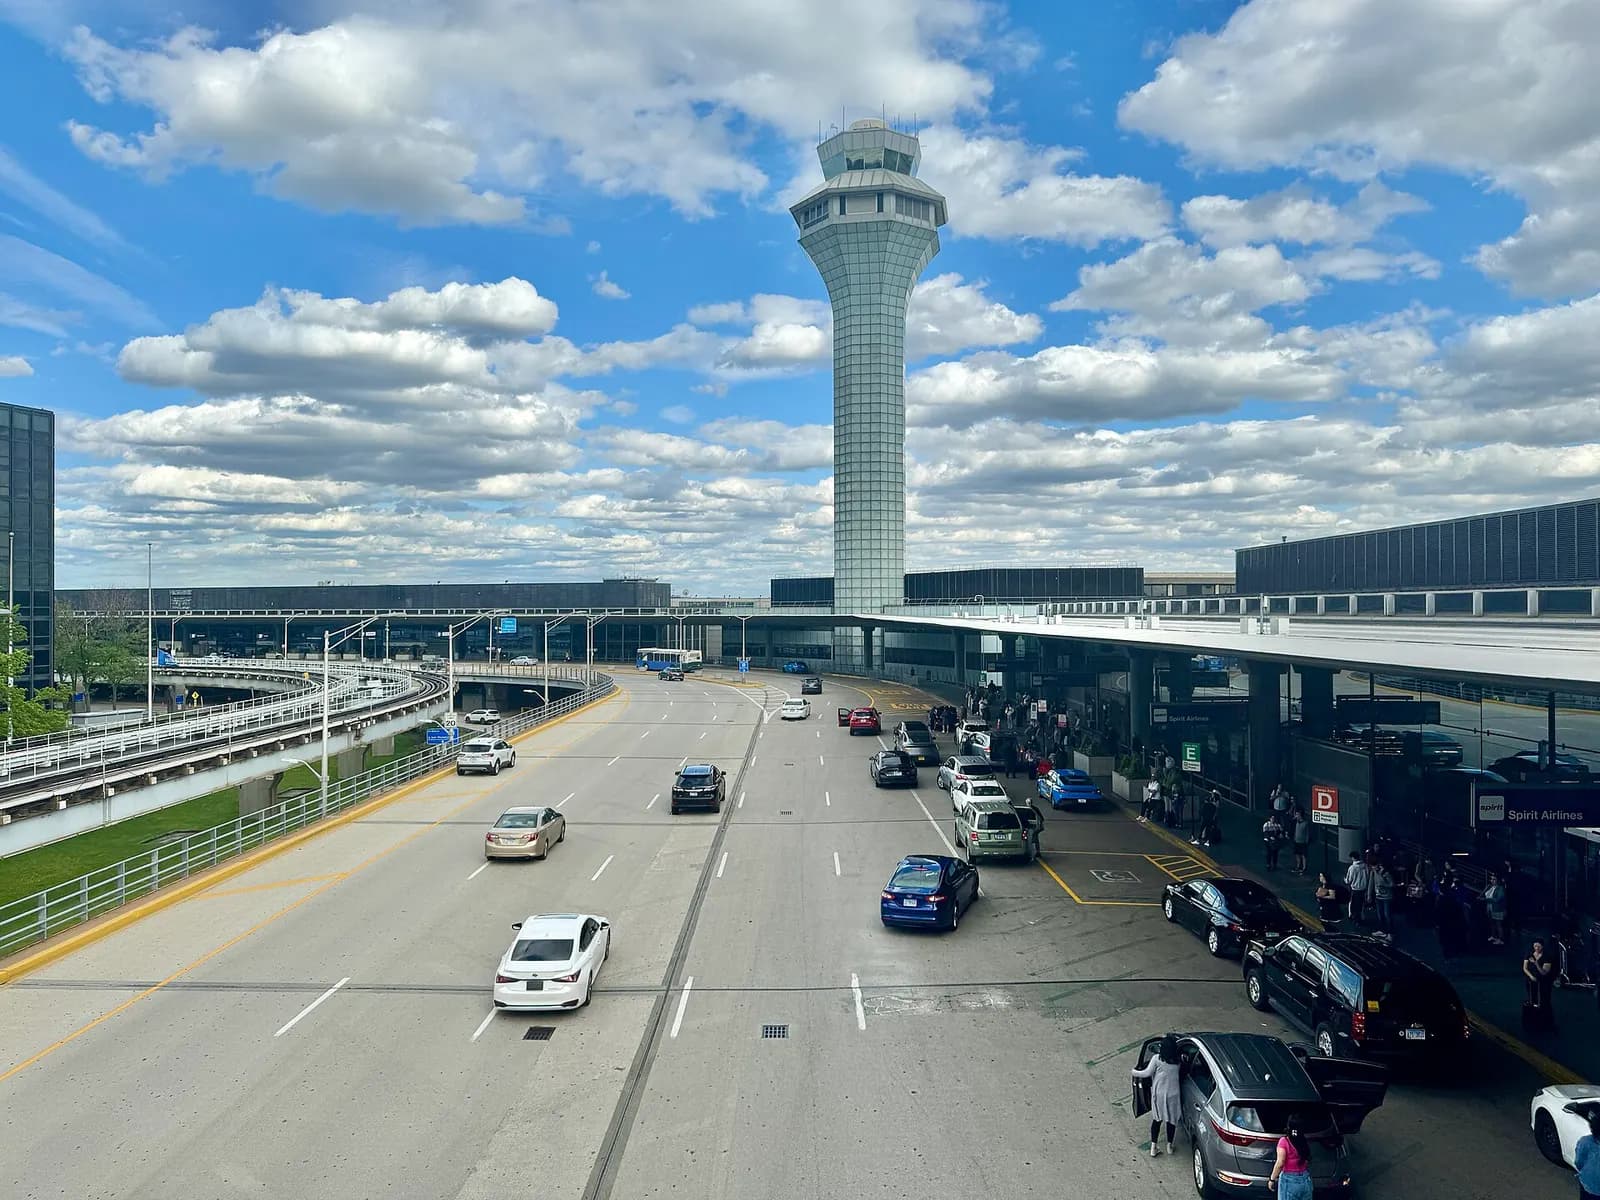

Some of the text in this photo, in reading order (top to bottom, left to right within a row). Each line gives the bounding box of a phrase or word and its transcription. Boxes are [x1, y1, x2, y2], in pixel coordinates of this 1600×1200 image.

[1186, 747, 1196, 760] E
[1317, 791, 1333, 809] D
[1480, 803, 1503, 812] spirit
[1508, 810, 1583, 821] Spirit Airlines
